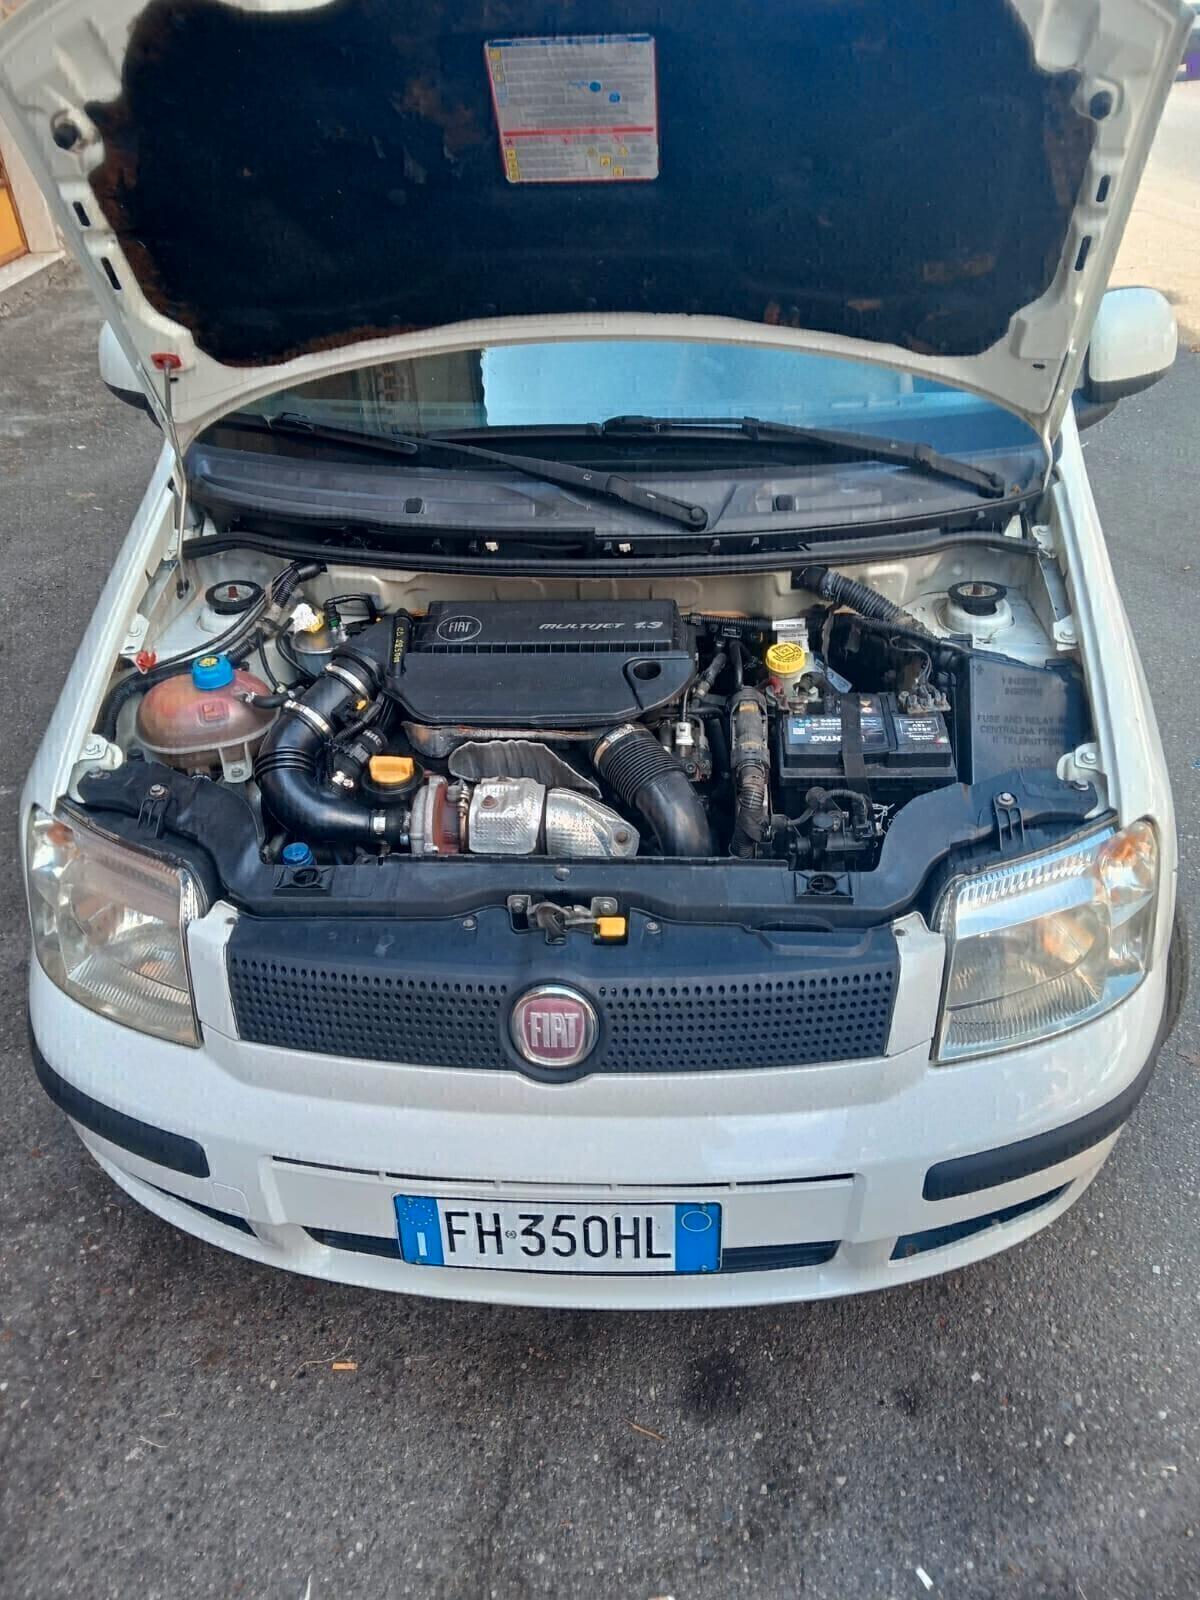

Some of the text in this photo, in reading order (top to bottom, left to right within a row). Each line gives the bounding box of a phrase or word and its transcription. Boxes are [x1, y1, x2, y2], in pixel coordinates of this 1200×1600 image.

[448, 621, 472, 633] FIAT
[538, 622, 625, 631] MULTIJET
[529, 1011, 579, 1049] FIAT
